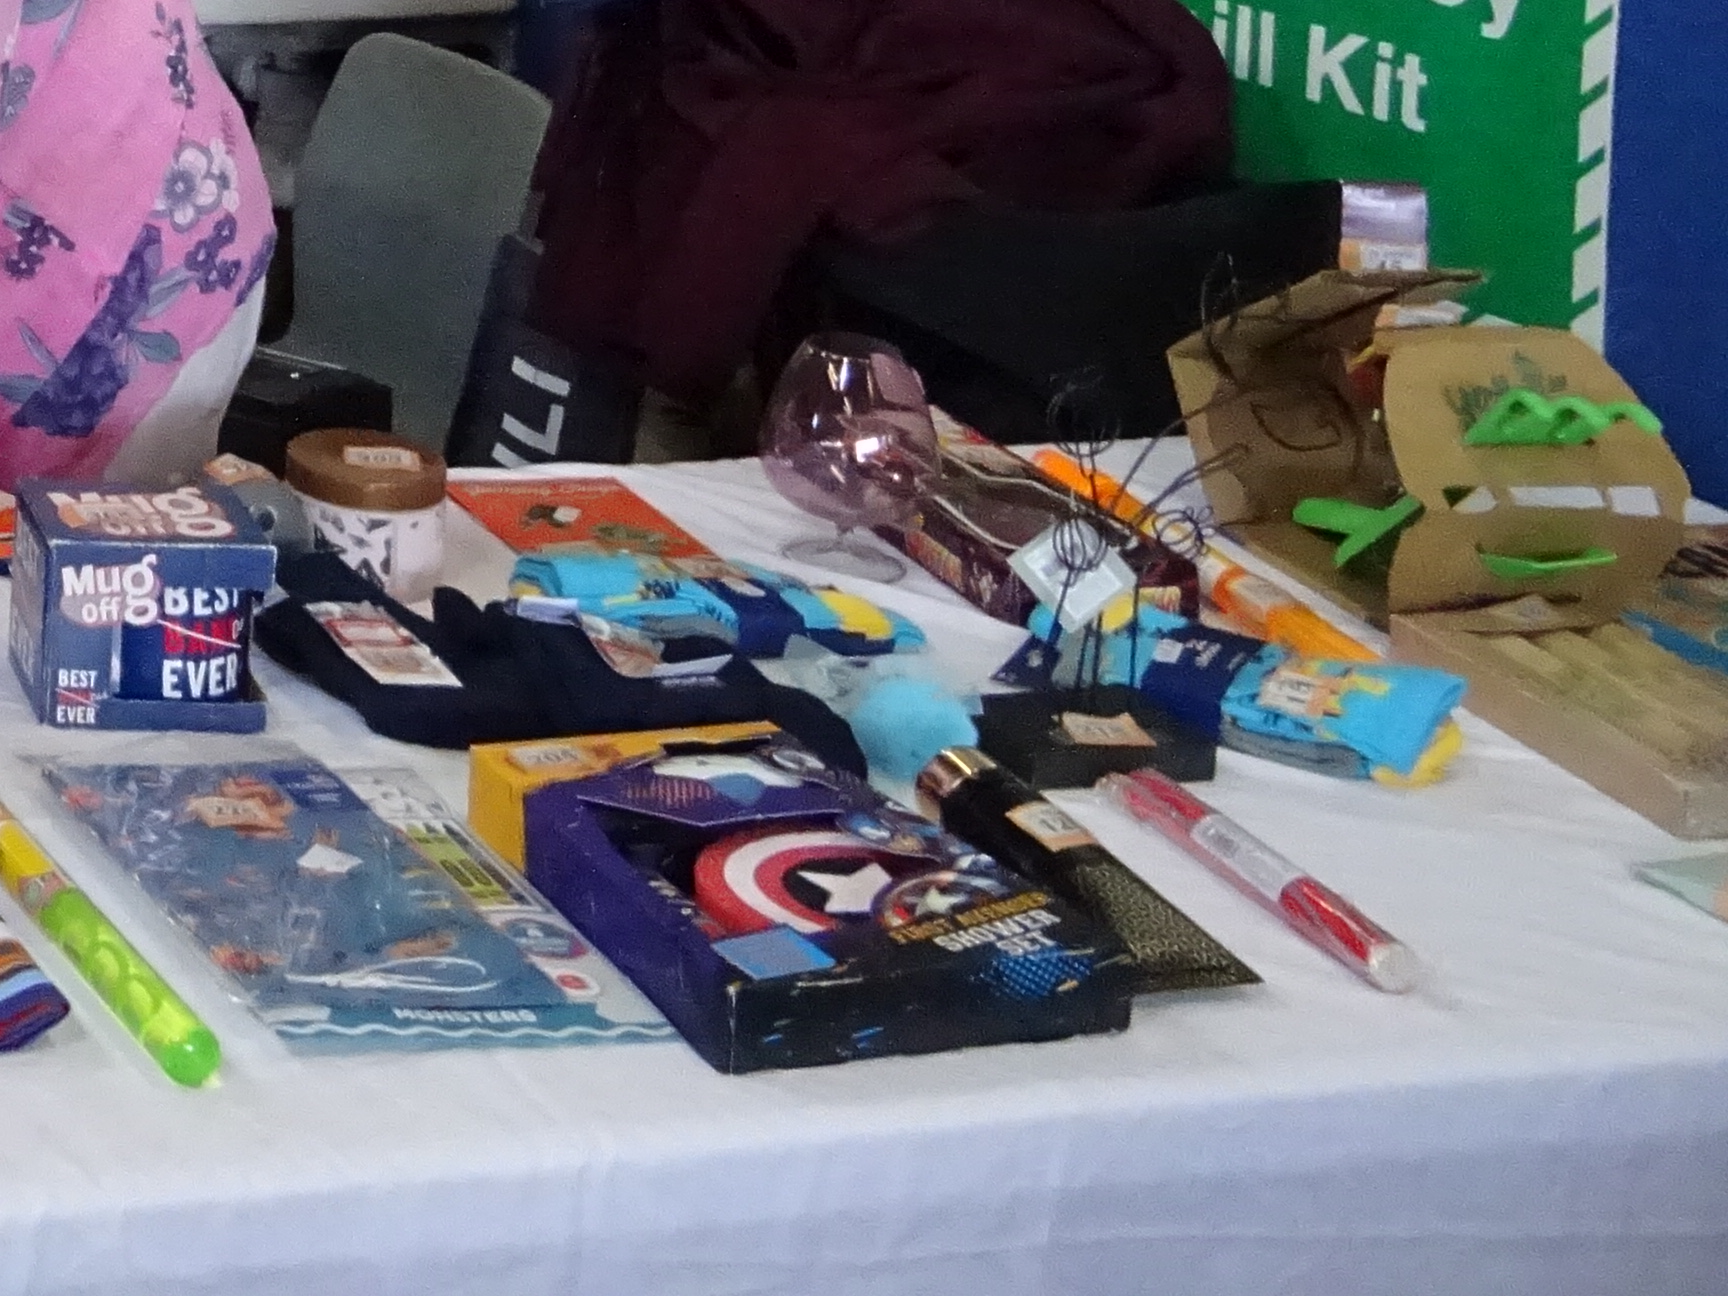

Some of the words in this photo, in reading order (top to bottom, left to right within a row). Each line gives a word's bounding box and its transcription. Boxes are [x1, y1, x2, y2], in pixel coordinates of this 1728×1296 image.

[1305, 23, 1428, 133] Kit
[61, 553, 158, 626] Mug
[81, 595, 122, 624] off
[57, 668, 98, 688] BEST
[161, 652, 238, 700] EVER
[56, 705, 96, 725] EVER
[933, 907, 1062, 952] SHOWER
[993, 931, 1058, 956] SET
